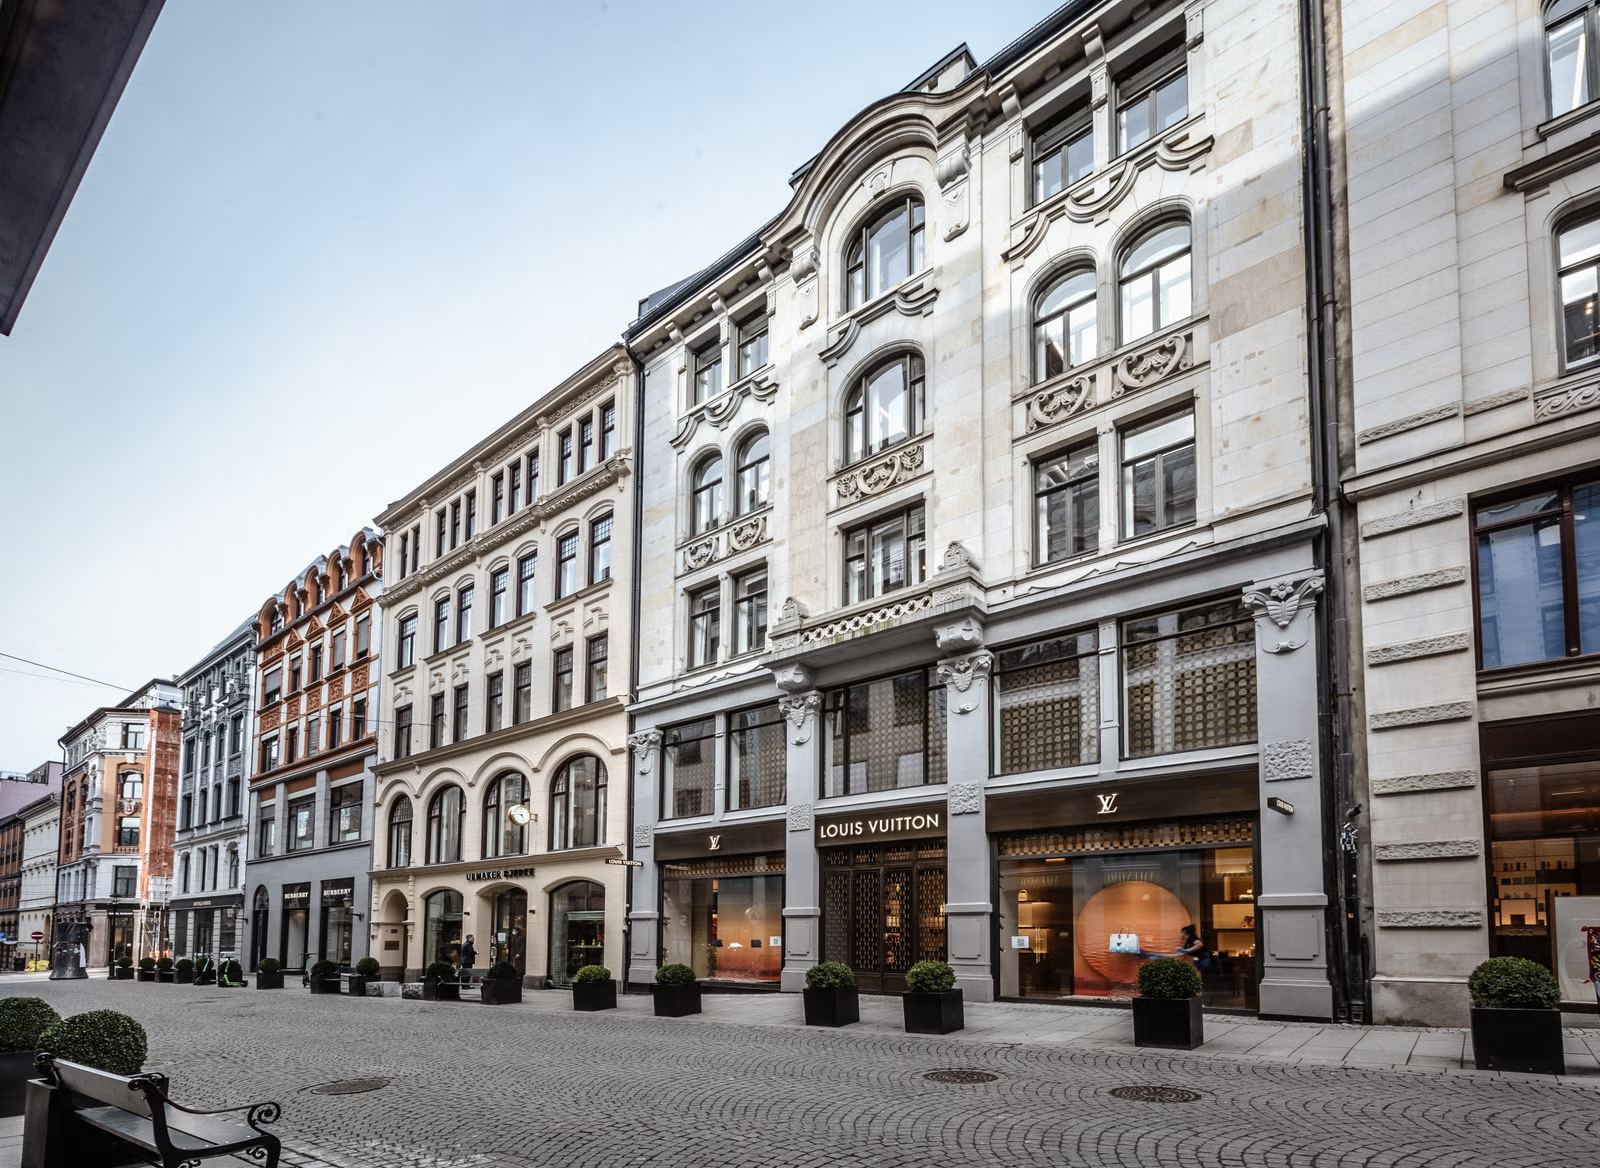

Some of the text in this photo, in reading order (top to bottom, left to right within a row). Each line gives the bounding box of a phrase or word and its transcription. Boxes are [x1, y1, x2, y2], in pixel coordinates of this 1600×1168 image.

[820, 814, 939, 838] LOUIS VUITTON
[466, 871, 502, 881] URMAKER
